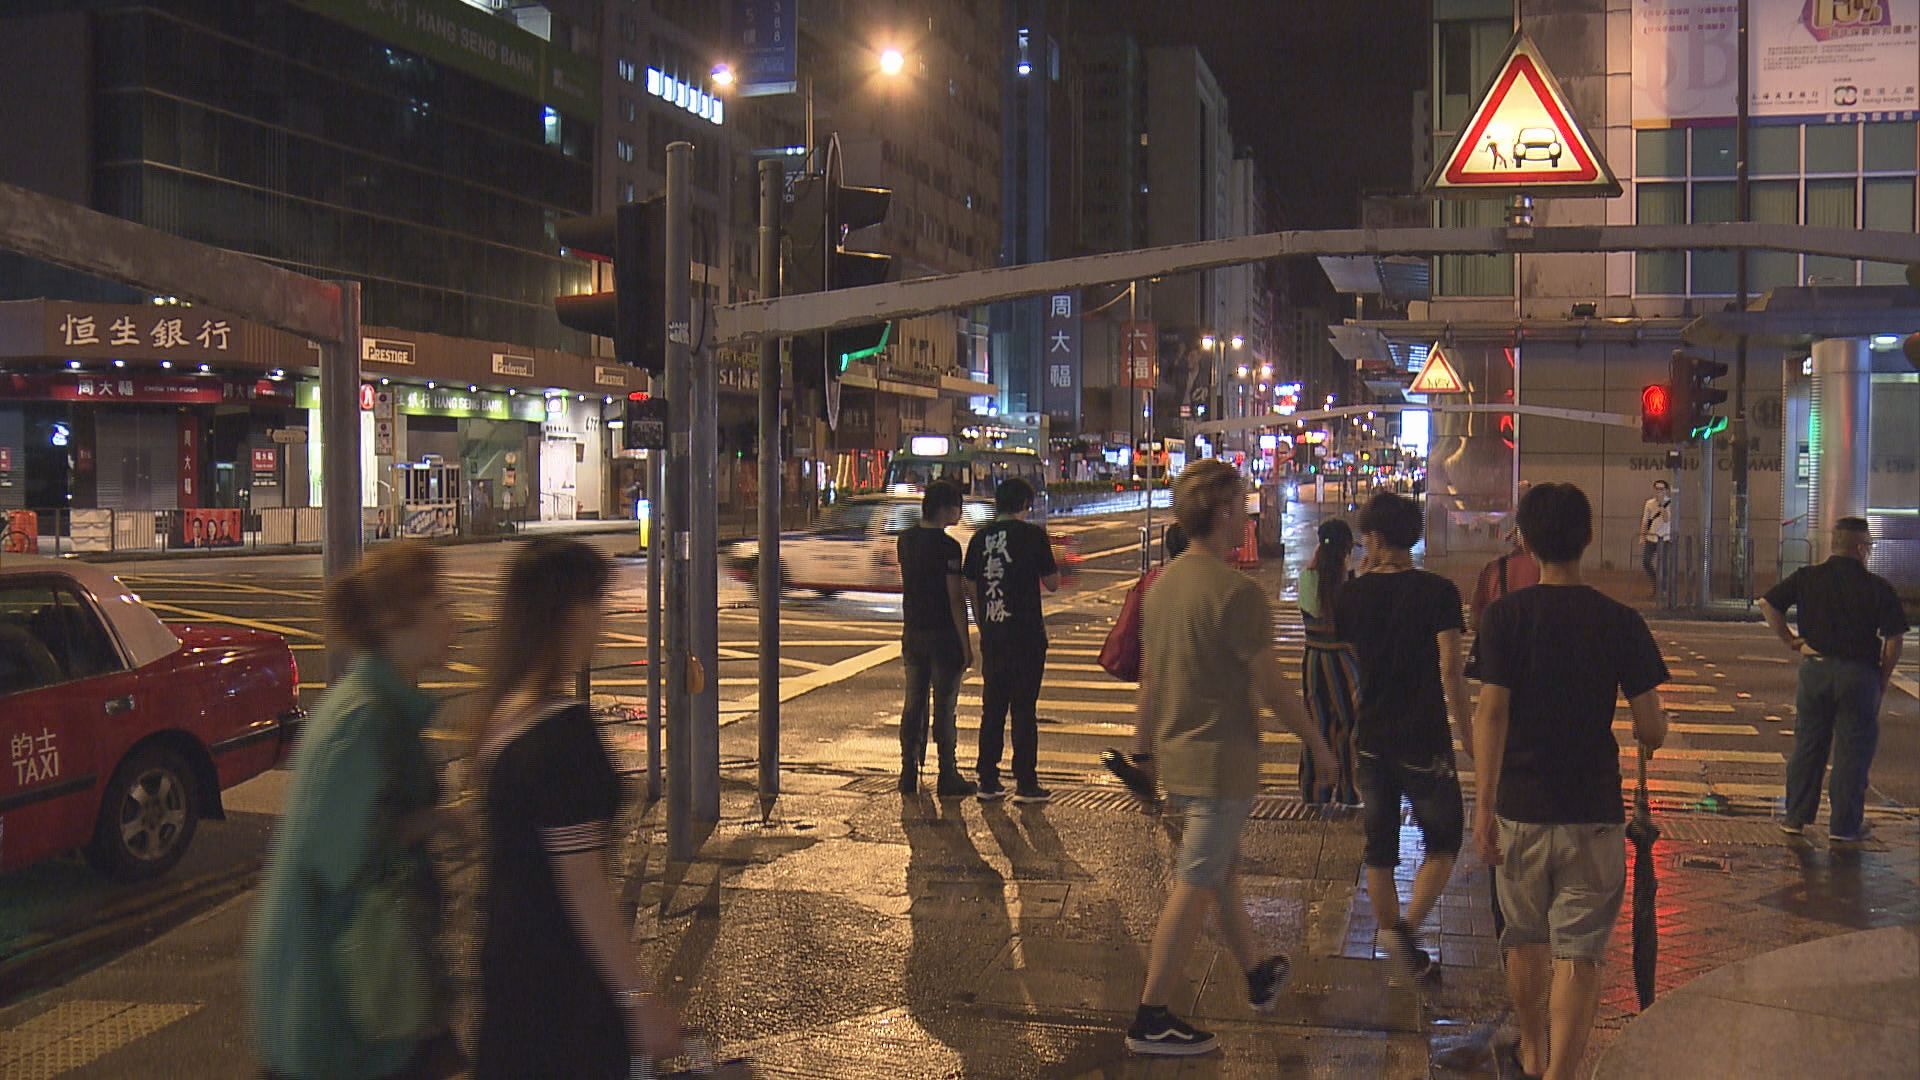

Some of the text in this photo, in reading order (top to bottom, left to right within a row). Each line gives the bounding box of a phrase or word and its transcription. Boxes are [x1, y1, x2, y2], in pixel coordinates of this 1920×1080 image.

[416, 8, 536, 79] HANG SENG BANK
[60, 313, 231, 350] 恒生銀行
[1050, 295, 1071, 388] 周大福
[368, 345, 409, 363] PRESTIGE
[1127, 329, 1149, 380] 六福
[77, 380, 134, 396] 周大福
[11, 727, 57, 760] 的士
[12, 752, 59, 786] TAXI
